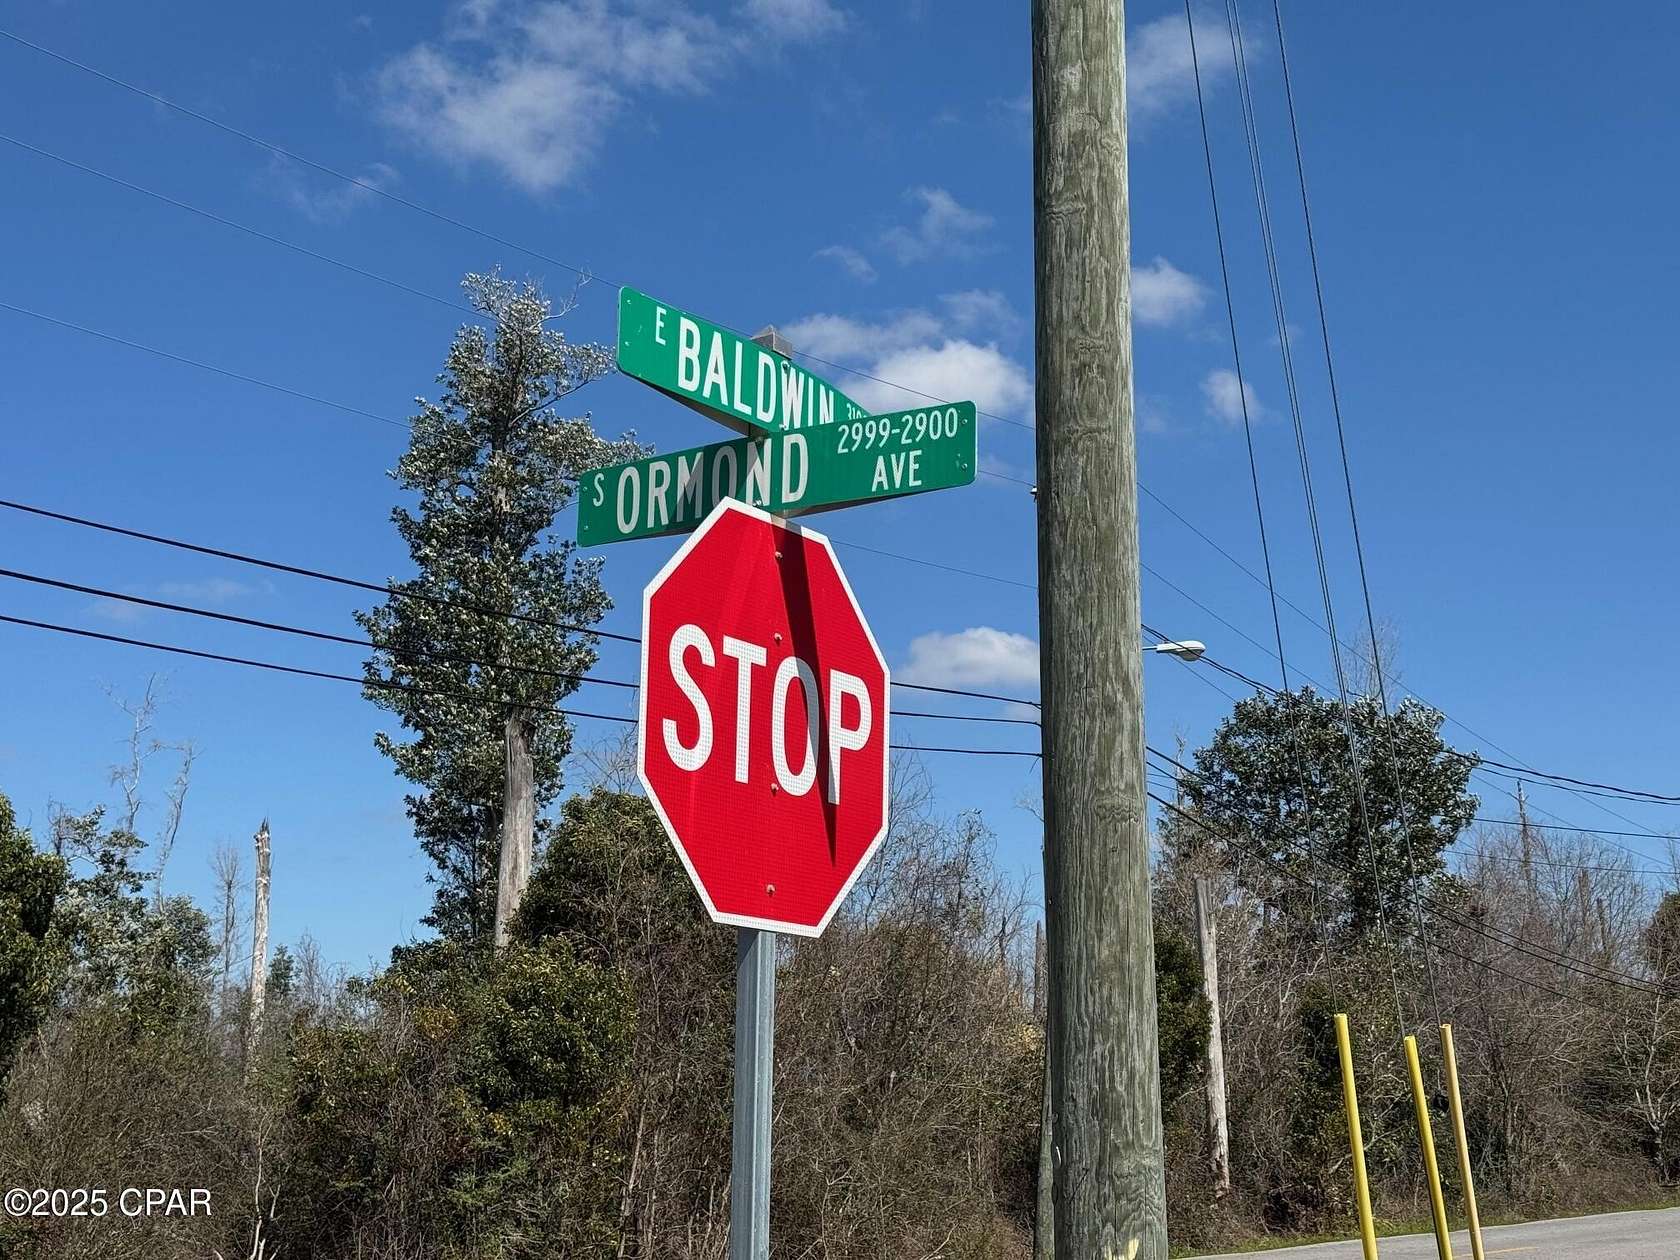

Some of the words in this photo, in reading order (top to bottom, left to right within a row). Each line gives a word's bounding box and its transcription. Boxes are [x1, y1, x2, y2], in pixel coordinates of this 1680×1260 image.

[655, 306, 667, 345] E
[677, 316, 835, 431] BALDWIN
[592, 472, 605, 508] S
[616, 433, 809, 534] ORMOND
[871, 449, 923, 493] AVE
[837, 407, 958, 454] 2999-2900
[662, 624, 872, 806] STOP
